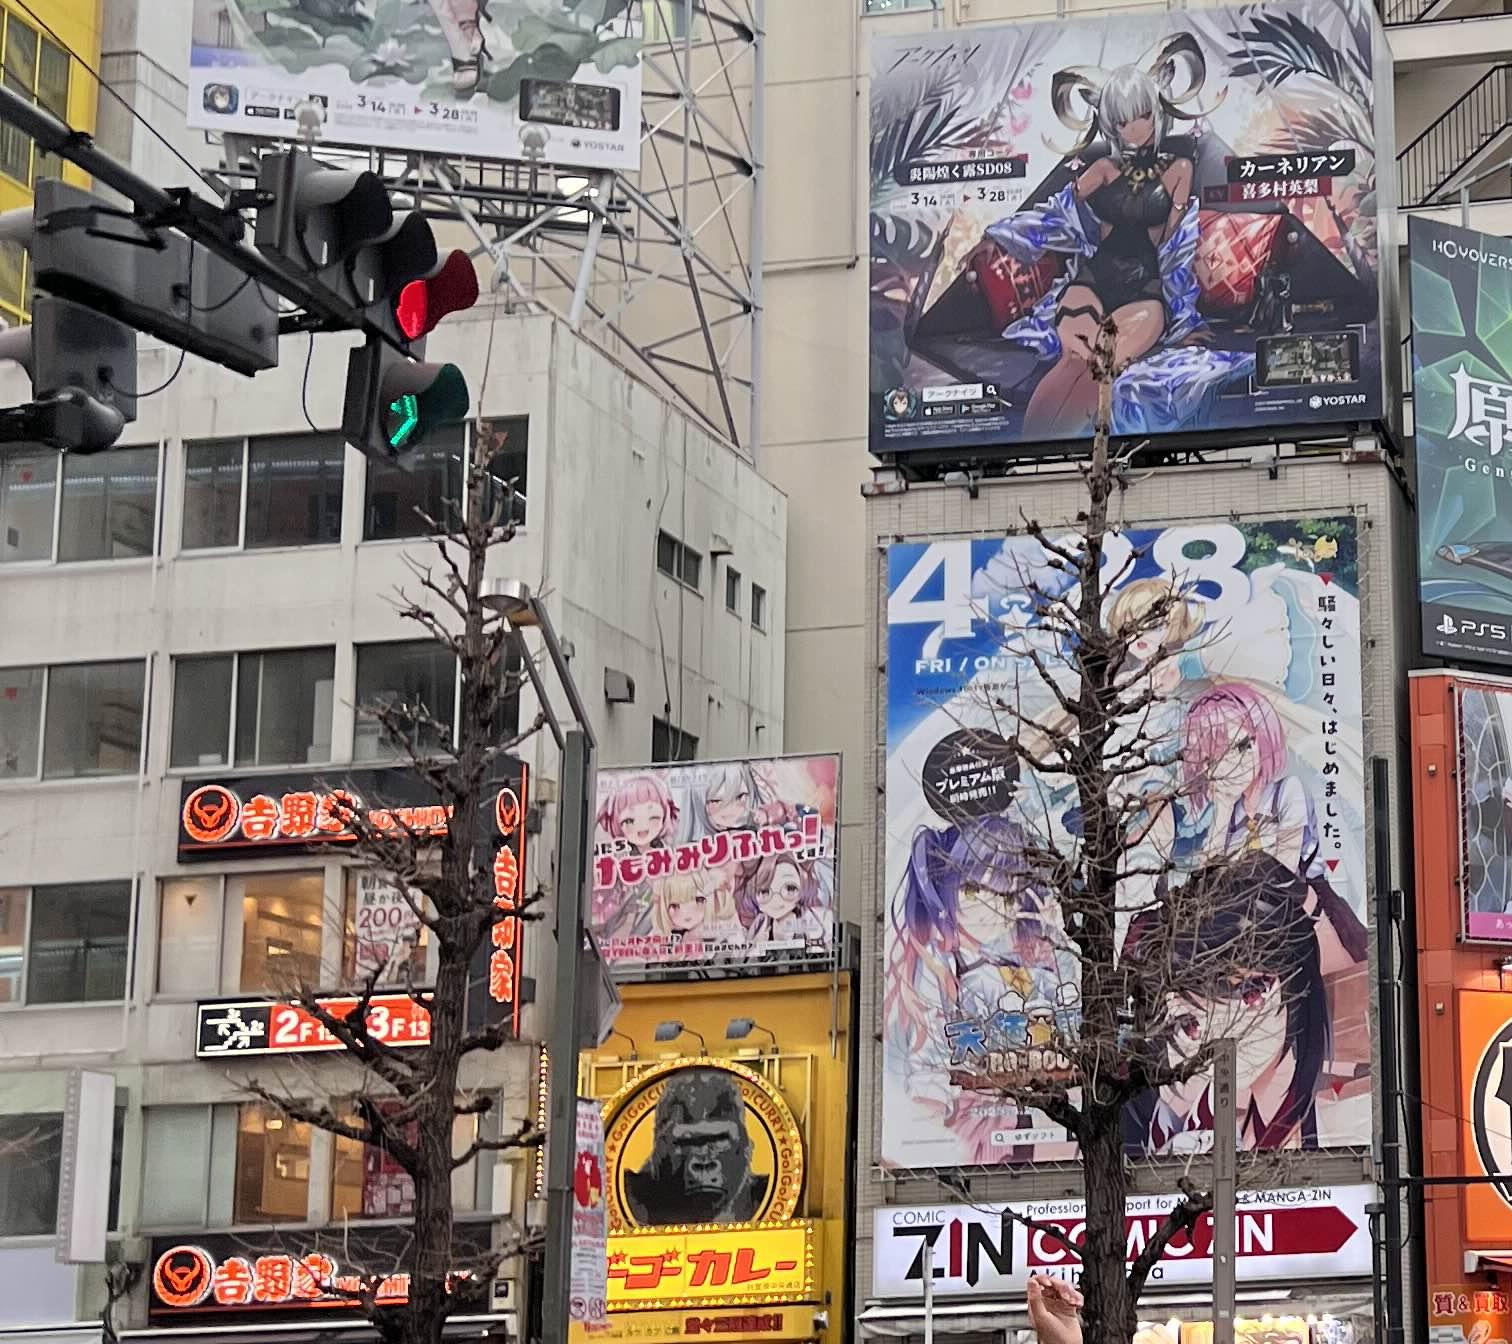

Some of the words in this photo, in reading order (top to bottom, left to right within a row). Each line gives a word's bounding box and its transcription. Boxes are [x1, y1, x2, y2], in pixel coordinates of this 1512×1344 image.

[1240, 155, 1345, 178] カーネリアン
[989, 191, 1006, 202] 28
[1242, 179, 1318, 199] 喜多村英梨
[924, 196, 937, 207] 14
[1322, 394, 1366, 406] YOSTAR
[1461, 620, 1506, 640] PS5
[915, 657, 951, 674] FRI
[974, 656, 1005, 671] ON
[1317, 595, 1342, 850] 騒々しい日々、はじめました。
[1156, 1197, 1173, 1209] for
[1254, 1189, 1332, 1205] MANGA-ZIN
[892, 1210, 946, 1225] COMIC
[893, 1206, 1014, 1288] ZIN
[214, 1254, 332, 1304] 吉野家
